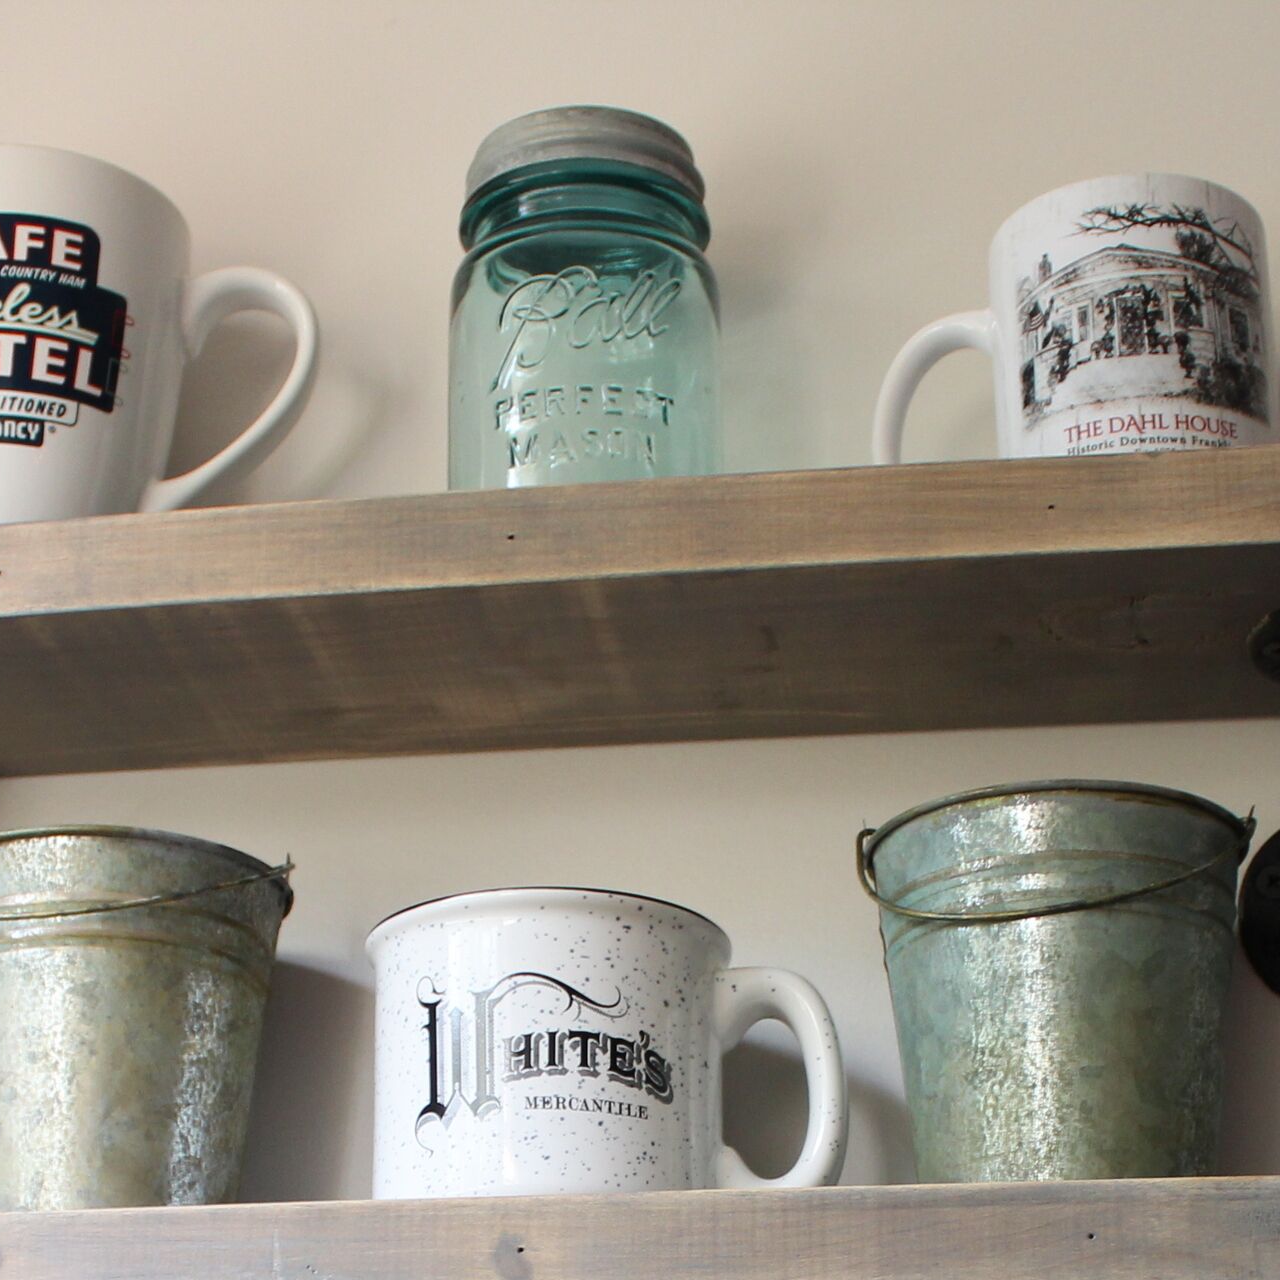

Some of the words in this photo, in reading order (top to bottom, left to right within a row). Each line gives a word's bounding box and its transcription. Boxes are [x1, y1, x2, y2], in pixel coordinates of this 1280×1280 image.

[0, 265, 57, 283] COUNTRY
[58, 273, 87, 289] HAM
[491, 265, 682, 392] Ball
[1064, 418, 1103, 443] THE
[1108, 413, 1170, 435] DAHL
[1174, 413, 1239, 440] HOUSE
[508, 428, 657, 467] MASON
[1067, 438, 1115, 457] Historic
[1119, 435, 1187, 446] Downtown
[415, 972, 675, 1159] WHITE'S
[524, 1095, 650, 1120] MERCANTILE
